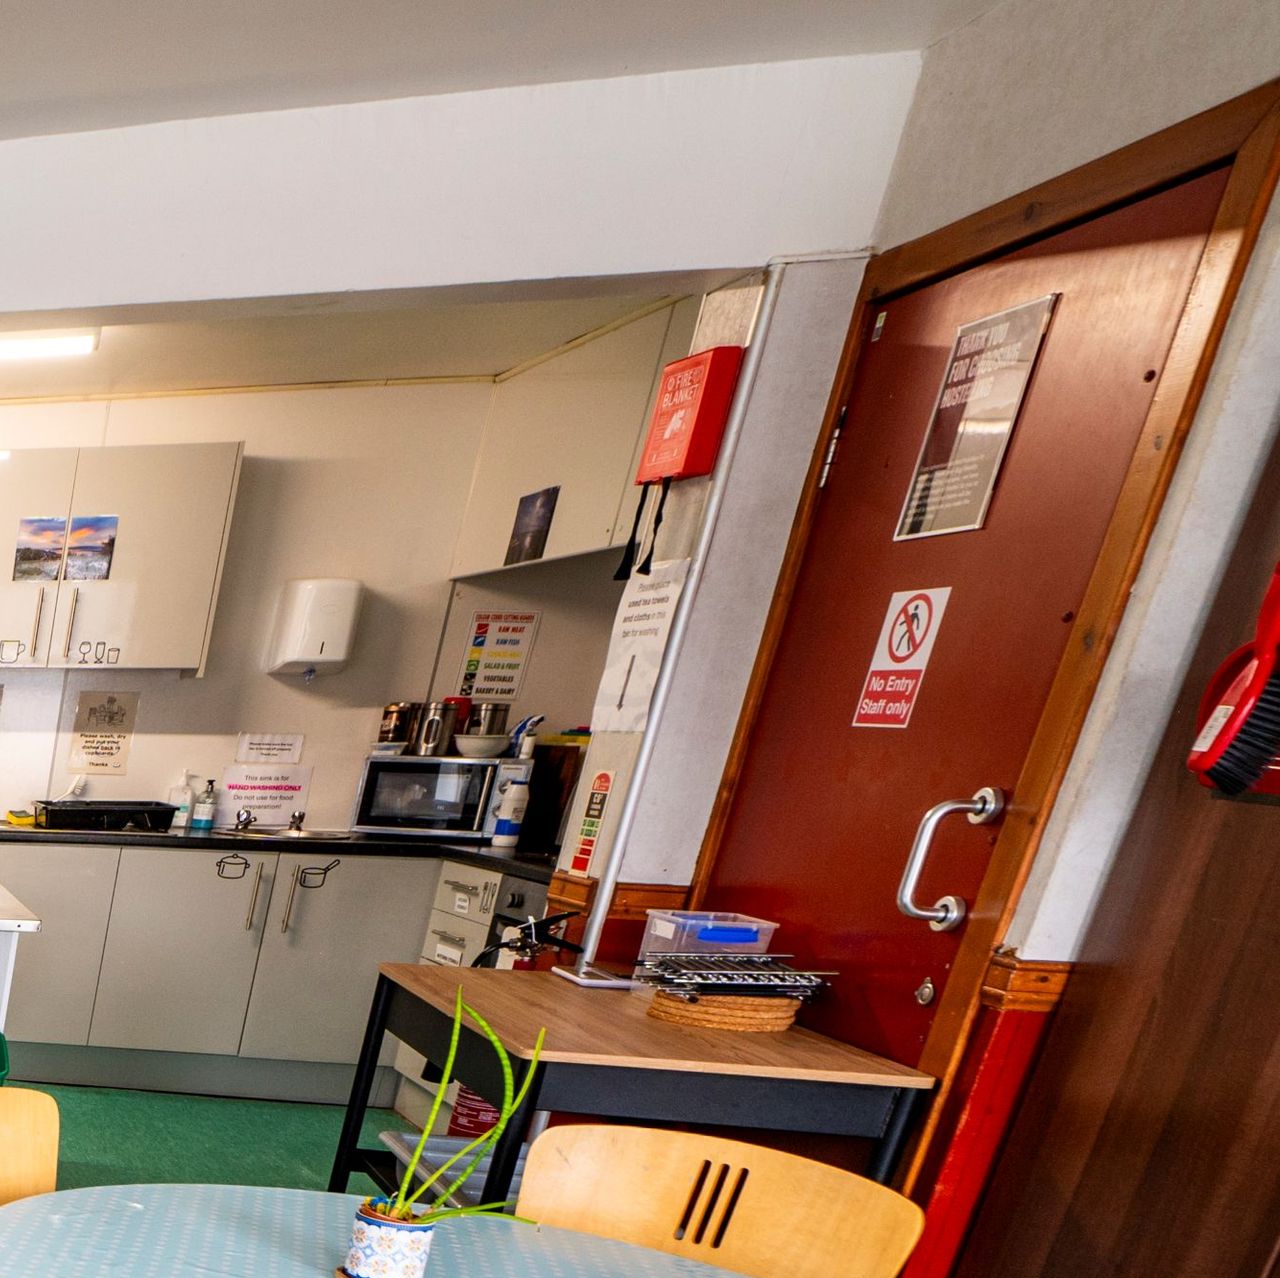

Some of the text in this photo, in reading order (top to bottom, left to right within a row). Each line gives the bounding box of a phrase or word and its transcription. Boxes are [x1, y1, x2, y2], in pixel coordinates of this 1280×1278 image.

[957, 329, 990, 357] THANK
[675, 373, 694, 390] FIRE
[947, 358, 971, 385] FOR
[663, 384, 699, 408] BLANKET
[868, 676, 916, 695] No Entry
[860, 698, 910, 719] Staff only
